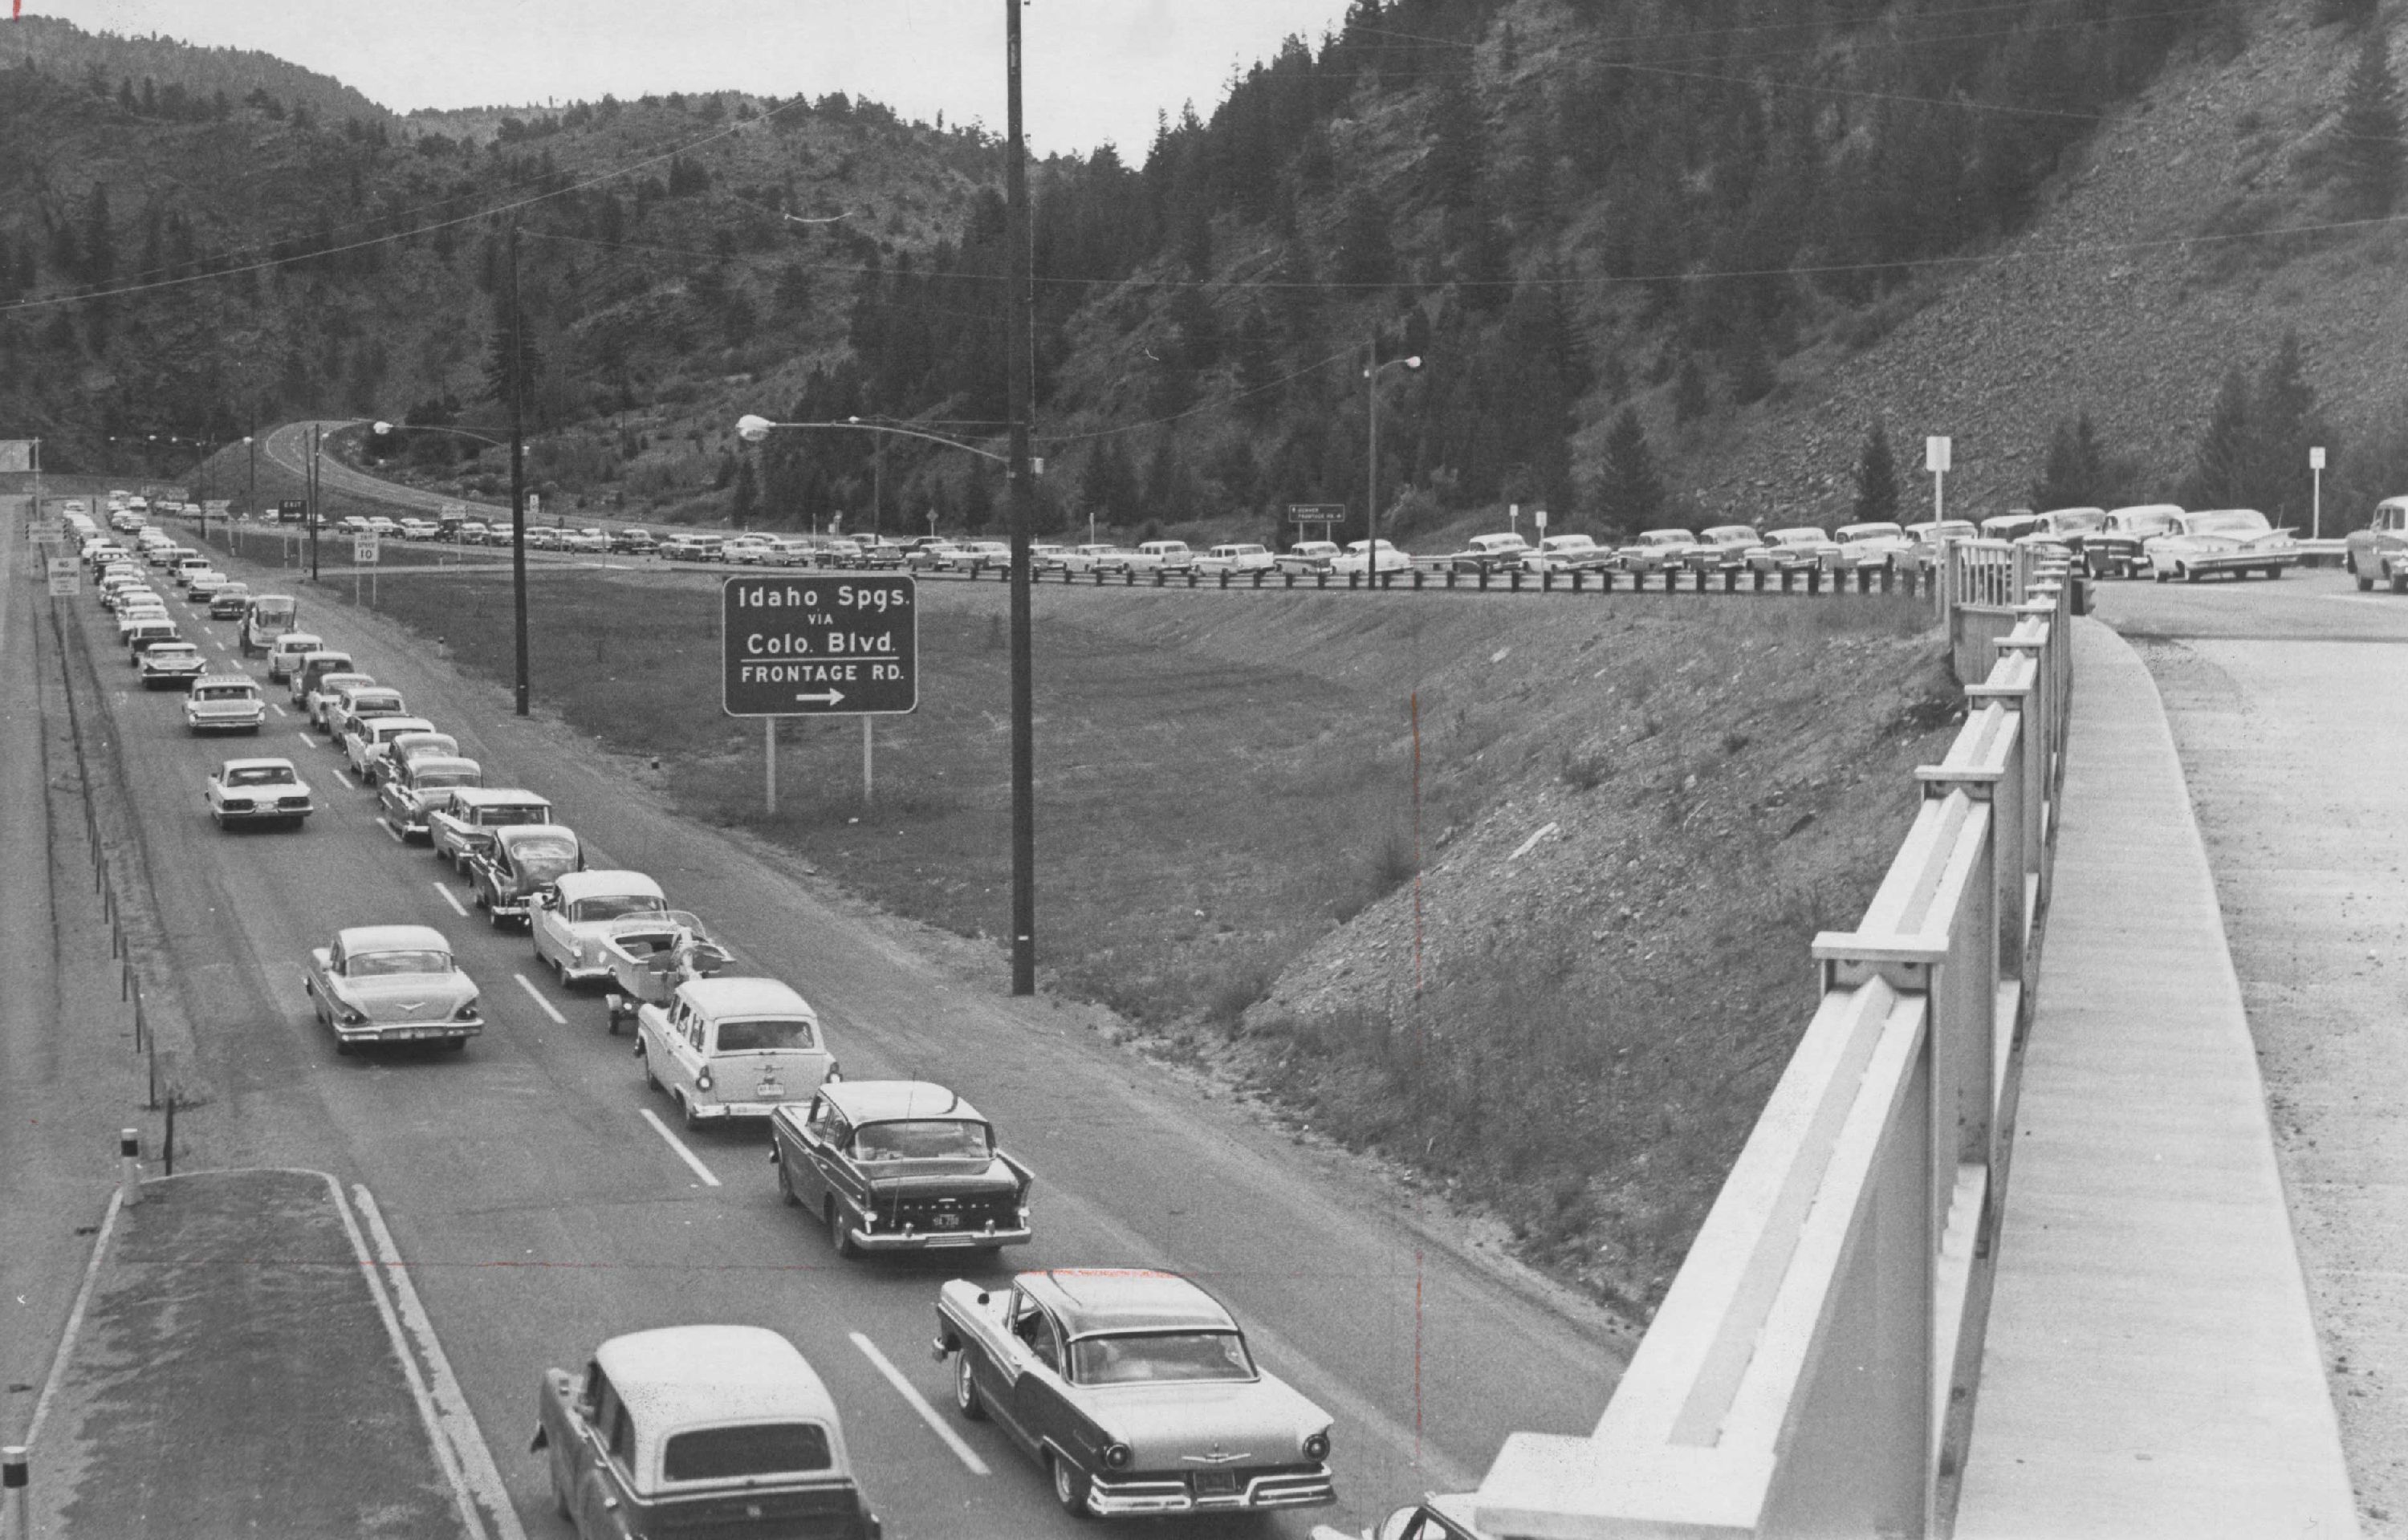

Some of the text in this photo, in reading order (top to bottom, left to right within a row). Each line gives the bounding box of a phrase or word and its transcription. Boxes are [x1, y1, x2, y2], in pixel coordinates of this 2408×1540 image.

[360, 549, 372, 559] 10
[739, 586, 910, 612] Idaho Spgs.
[747, 632, 896, 654] Colo. Blvd.
[742, 664, 905, 682] FRONTAGE RD.
